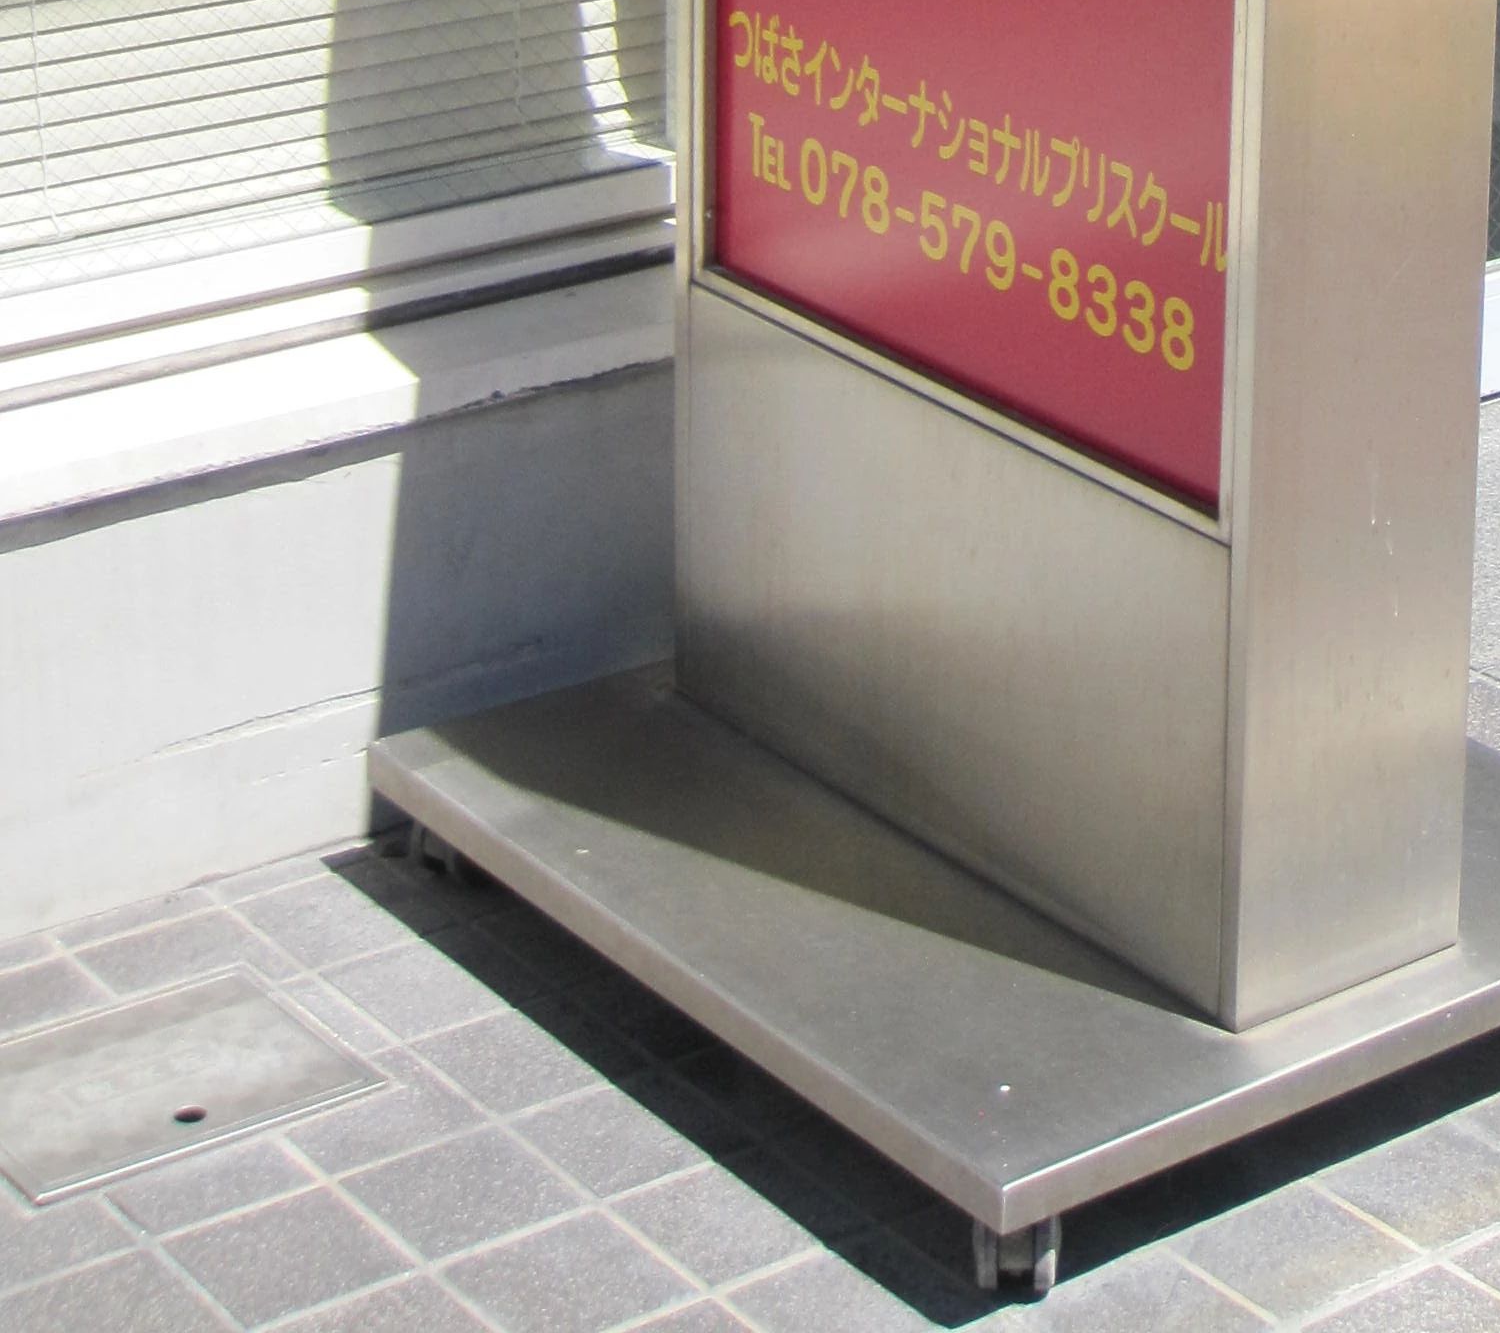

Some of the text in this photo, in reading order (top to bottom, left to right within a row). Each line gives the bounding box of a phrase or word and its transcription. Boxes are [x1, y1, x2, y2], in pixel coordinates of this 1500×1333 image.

[728, 10, 1228, 273] つばさインターナショナルプリスクール
[800, 137, 1196, 372] 078-579-8338
